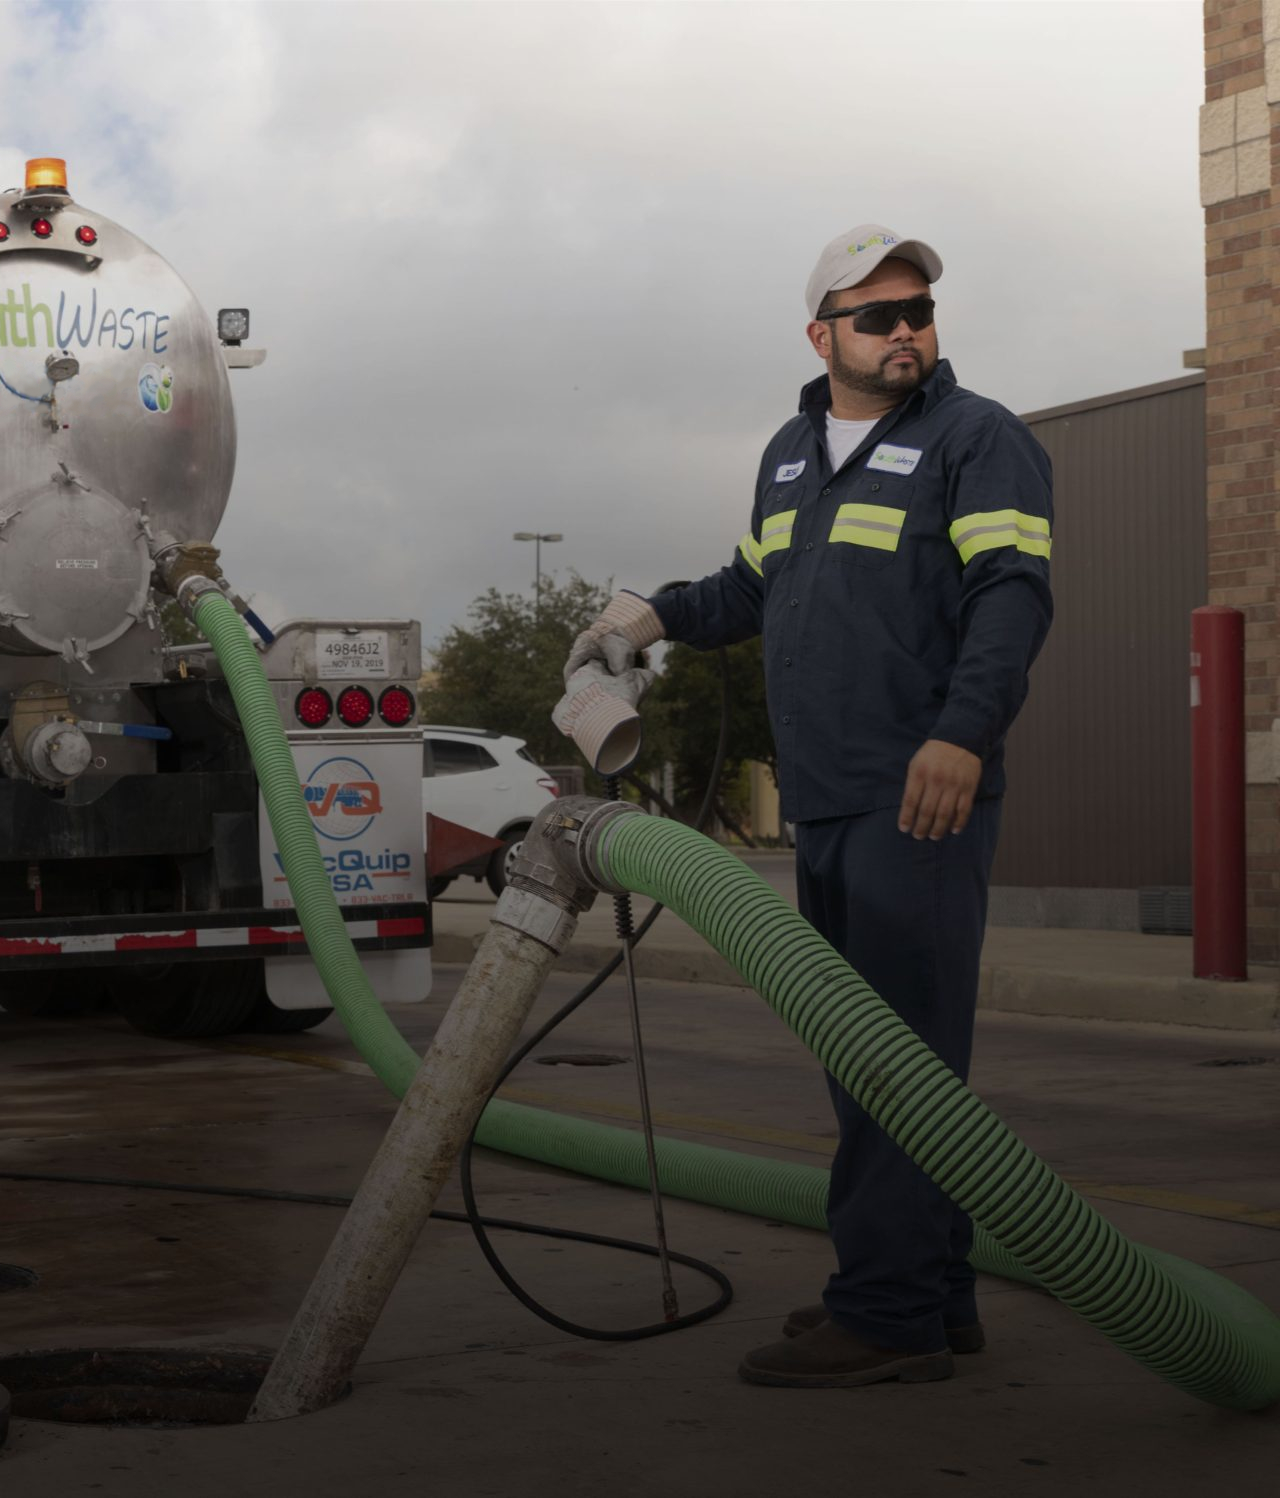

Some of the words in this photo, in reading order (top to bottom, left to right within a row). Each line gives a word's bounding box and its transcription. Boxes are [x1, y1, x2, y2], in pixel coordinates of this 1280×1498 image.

[325, 642, 380, 656] 49846J2
[332, 660, 349, 668] NOV
[364, 659, 384, 667] 2019
[327, 873, 374, 892] SA
